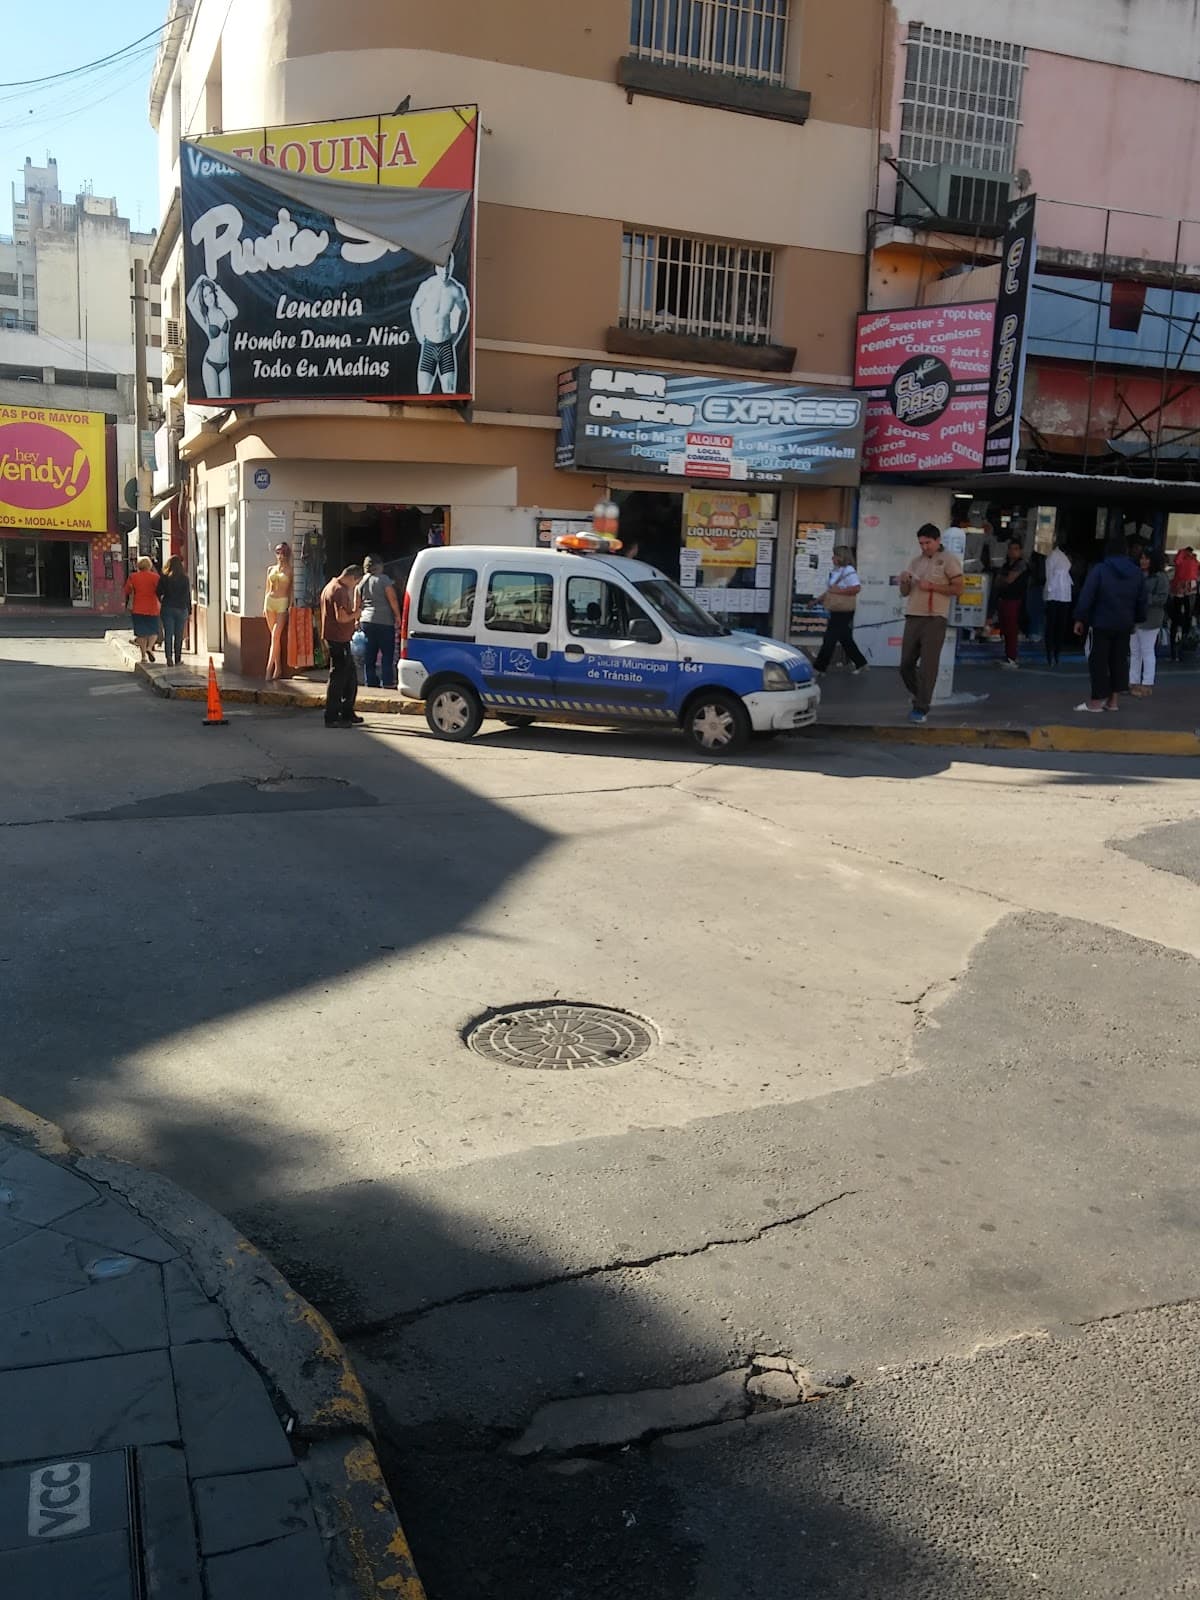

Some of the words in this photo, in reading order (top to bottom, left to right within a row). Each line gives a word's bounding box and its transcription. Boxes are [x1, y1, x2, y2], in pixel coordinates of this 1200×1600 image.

[275, 291, 364, 320] Lenceria
[234, 330, 297, 352] Hombre
[300, 329, 351, 350] Dama
[366, 325, 410, 347] Niño
[253, 358, 292, 378] Todo
[296, 358, 319, 377] En
[323, 355, 390, 378] Medias
[896, 381, 949, 418] PASO
[21, 410, 45, 420] POR
[49, 412, 89, 424] MAYOR
[703, 395, 861, 427] EXPRESS
[601, 426, 649, 442] Precio
[690, 434, 731, 447] ALQUILO
[15, 448, 40, 464] hey
[697, 447, 722, 456] LOCAL
[25, 517, 58, 527] MODAL
[67, 518, 92, 528] LANA
[623, 658, 670, 673] Municipal
[678, 662, 704, 673] 1641
[587, 669, 600, 679] de
[603, 669, 643, 682] Tránsito
